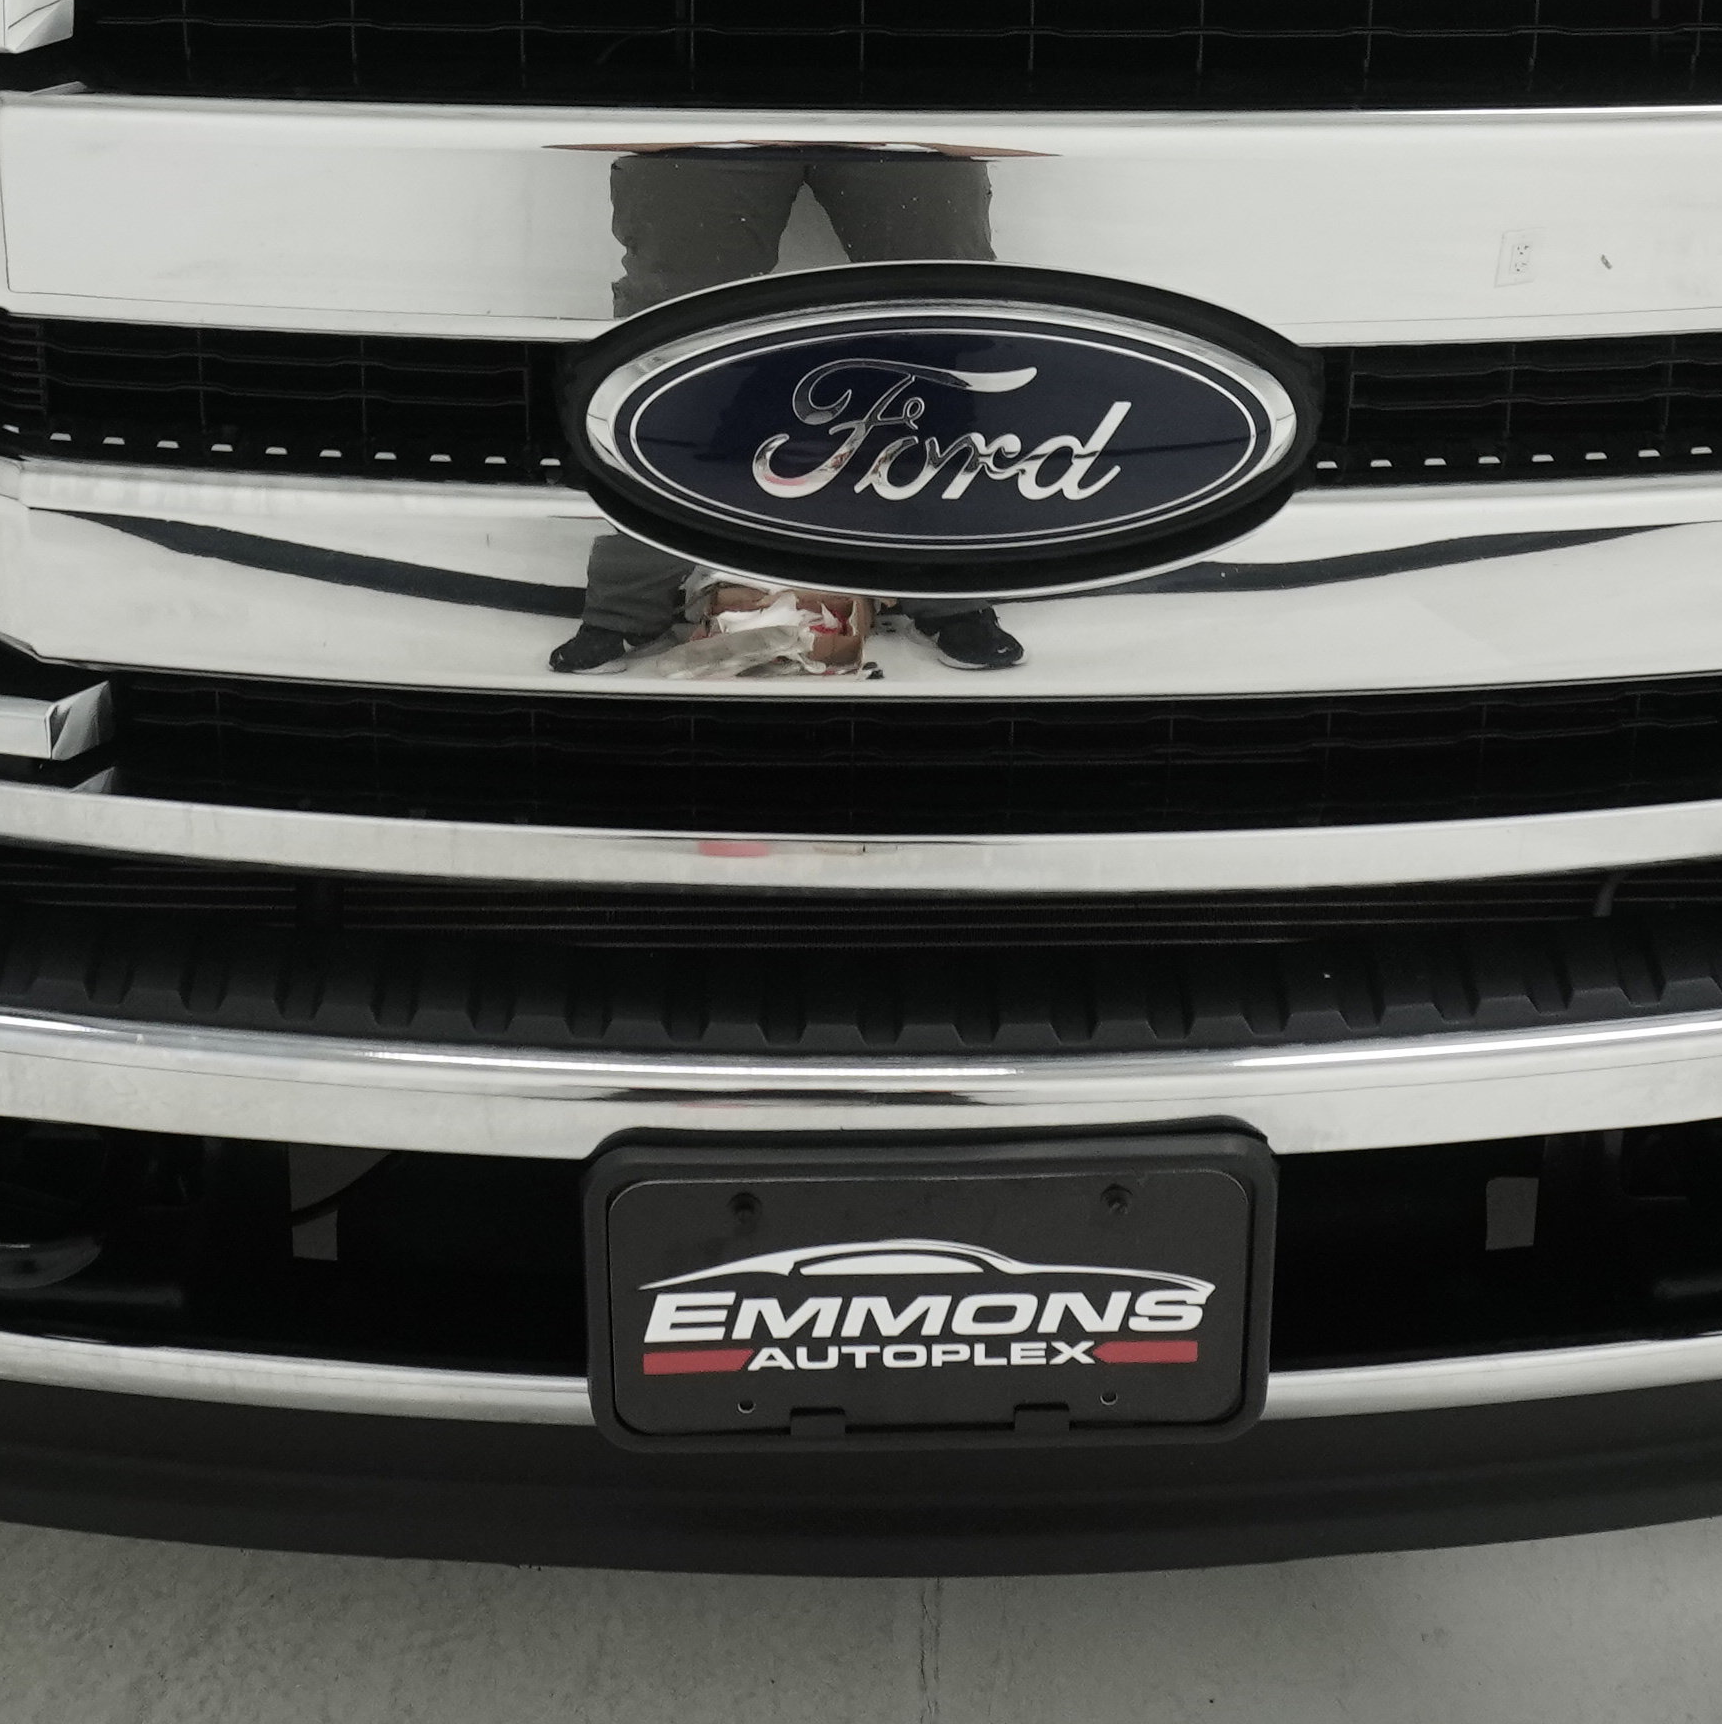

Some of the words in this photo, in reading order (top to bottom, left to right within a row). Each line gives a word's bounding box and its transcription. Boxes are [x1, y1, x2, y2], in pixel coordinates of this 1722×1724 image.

[751, 357, 1132, 501] Ford
[643, 1289, 1211, 1344] EMMONS
[747, 1339, 1097, 1371] AUTOPLEX
